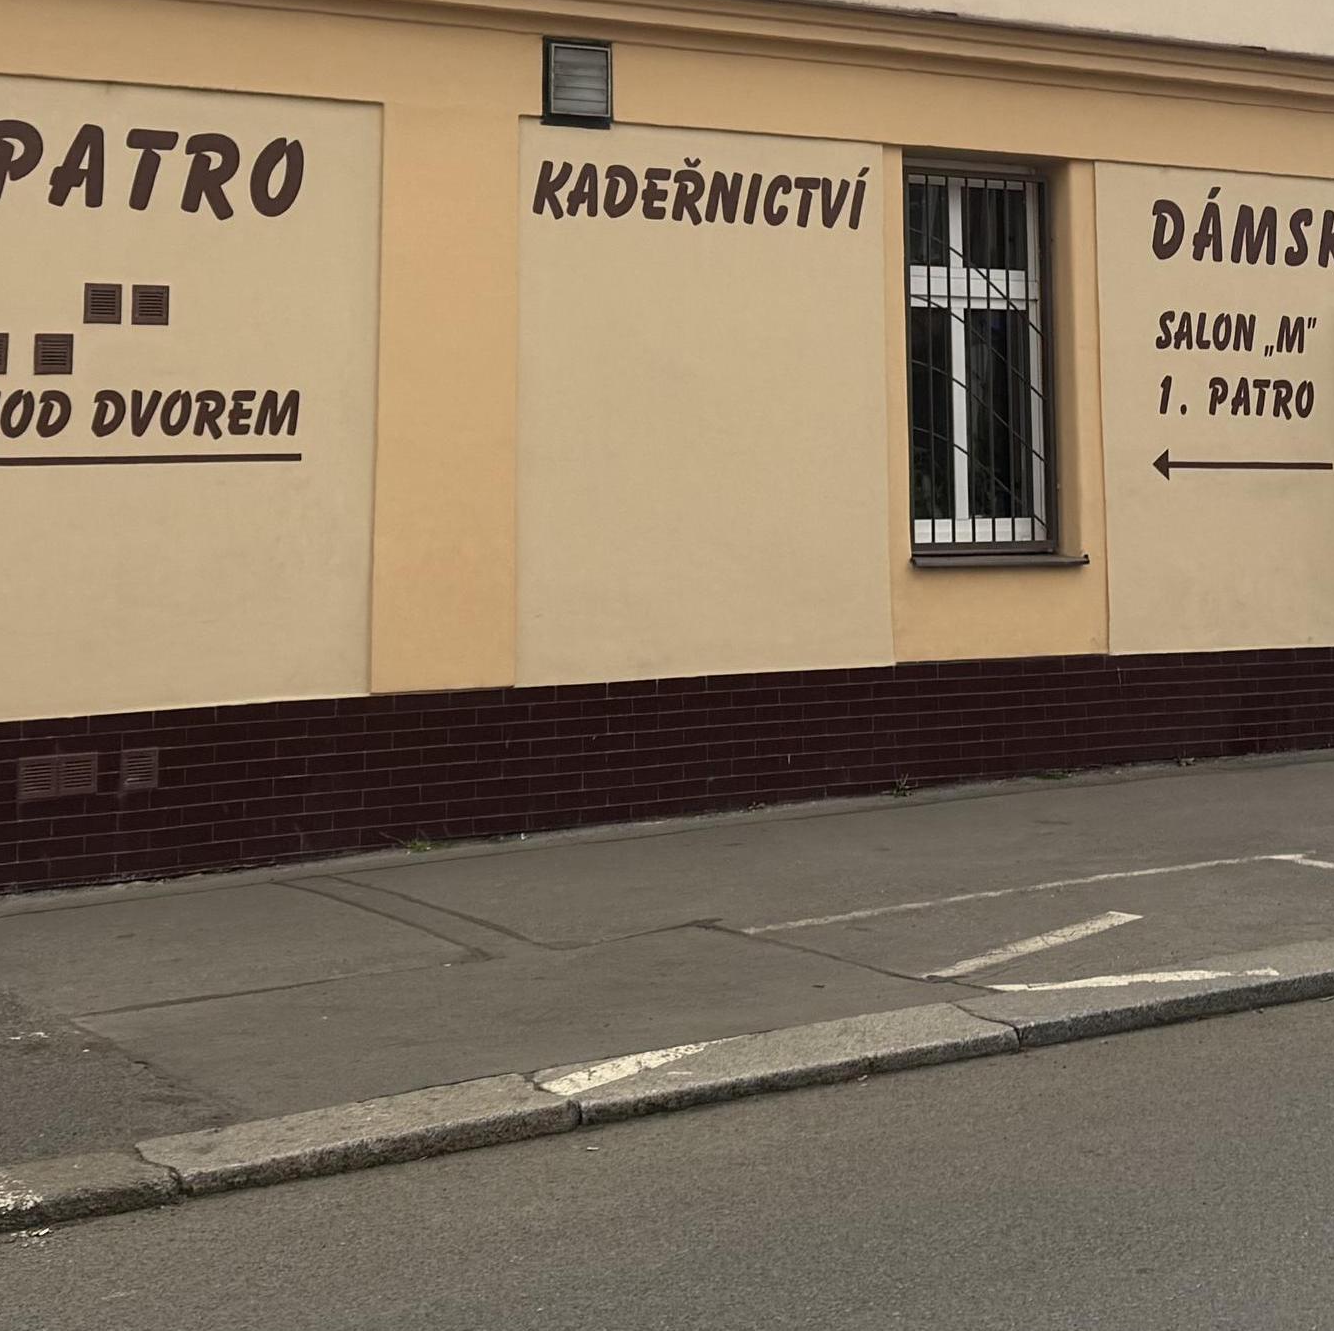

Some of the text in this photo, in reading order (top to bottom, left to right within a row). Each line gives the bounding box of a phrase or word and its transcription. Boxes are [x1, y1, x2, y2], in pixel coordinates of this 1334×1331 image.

[532, 157, 870, 230] KADEŘNICTVÍ
[1155, 311, 1256, 352] SALON
[91, 389, 301, 440] DVOREM
[1159, 375, 1315, 421] 1. PATRO
